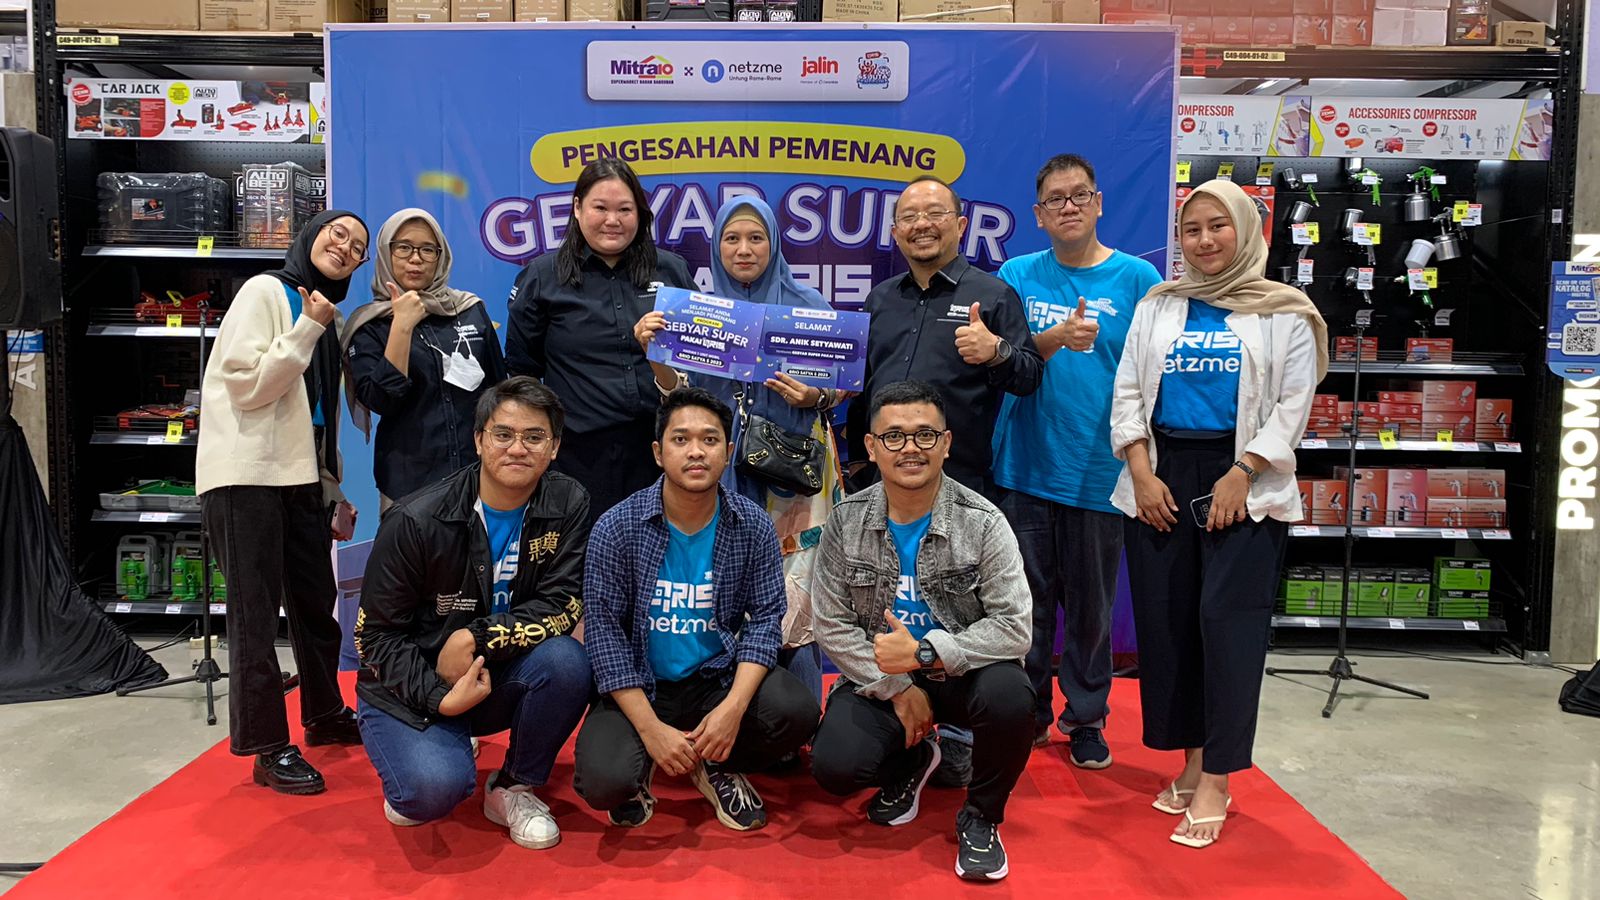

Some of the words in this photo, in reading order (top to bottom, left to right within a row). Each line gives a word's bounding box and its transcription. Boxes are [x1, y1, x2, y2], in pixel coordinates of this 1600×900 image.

[611, 58, 674, 75] Mitra10
[729, 62, 782, 73] netzme
[801, 56, 839, 77] jalin
[101, 84, 127, 94] CAR
[131, 84, 160, 94] JACK
[1178, 105, 1234, 116] OMPRESSOR
[1349, 108, 1410, 119] ACCESSORIES
[1414, 109, 1477, 120] COMPRESSOR
[561, 136, 759, 168] PENGESAHAN
[770, 137, 936, 170] PEMENANG
[250, 172, 286, 180] AUTO
[789, 265, 872, 302] RIS
[689, 304, 714, 312] SELAMAT
[715, 309, 731, 317] ANDA
[706, 313, 736, 324] PEMENANG
[795, 322, 832, 332] SELAMAT
[664, 321, 709, 336] GEBYAR
[711, 328, 749, 347] SUPER
[680, 335, 702, 345] PAKAI
[771, 336, 788, 344] SDR.
[790, 338, 809, 346] ANIK
[811, 340, 853, 350] SETYAWATI
[1164, 354, 1240, 373] etzme
